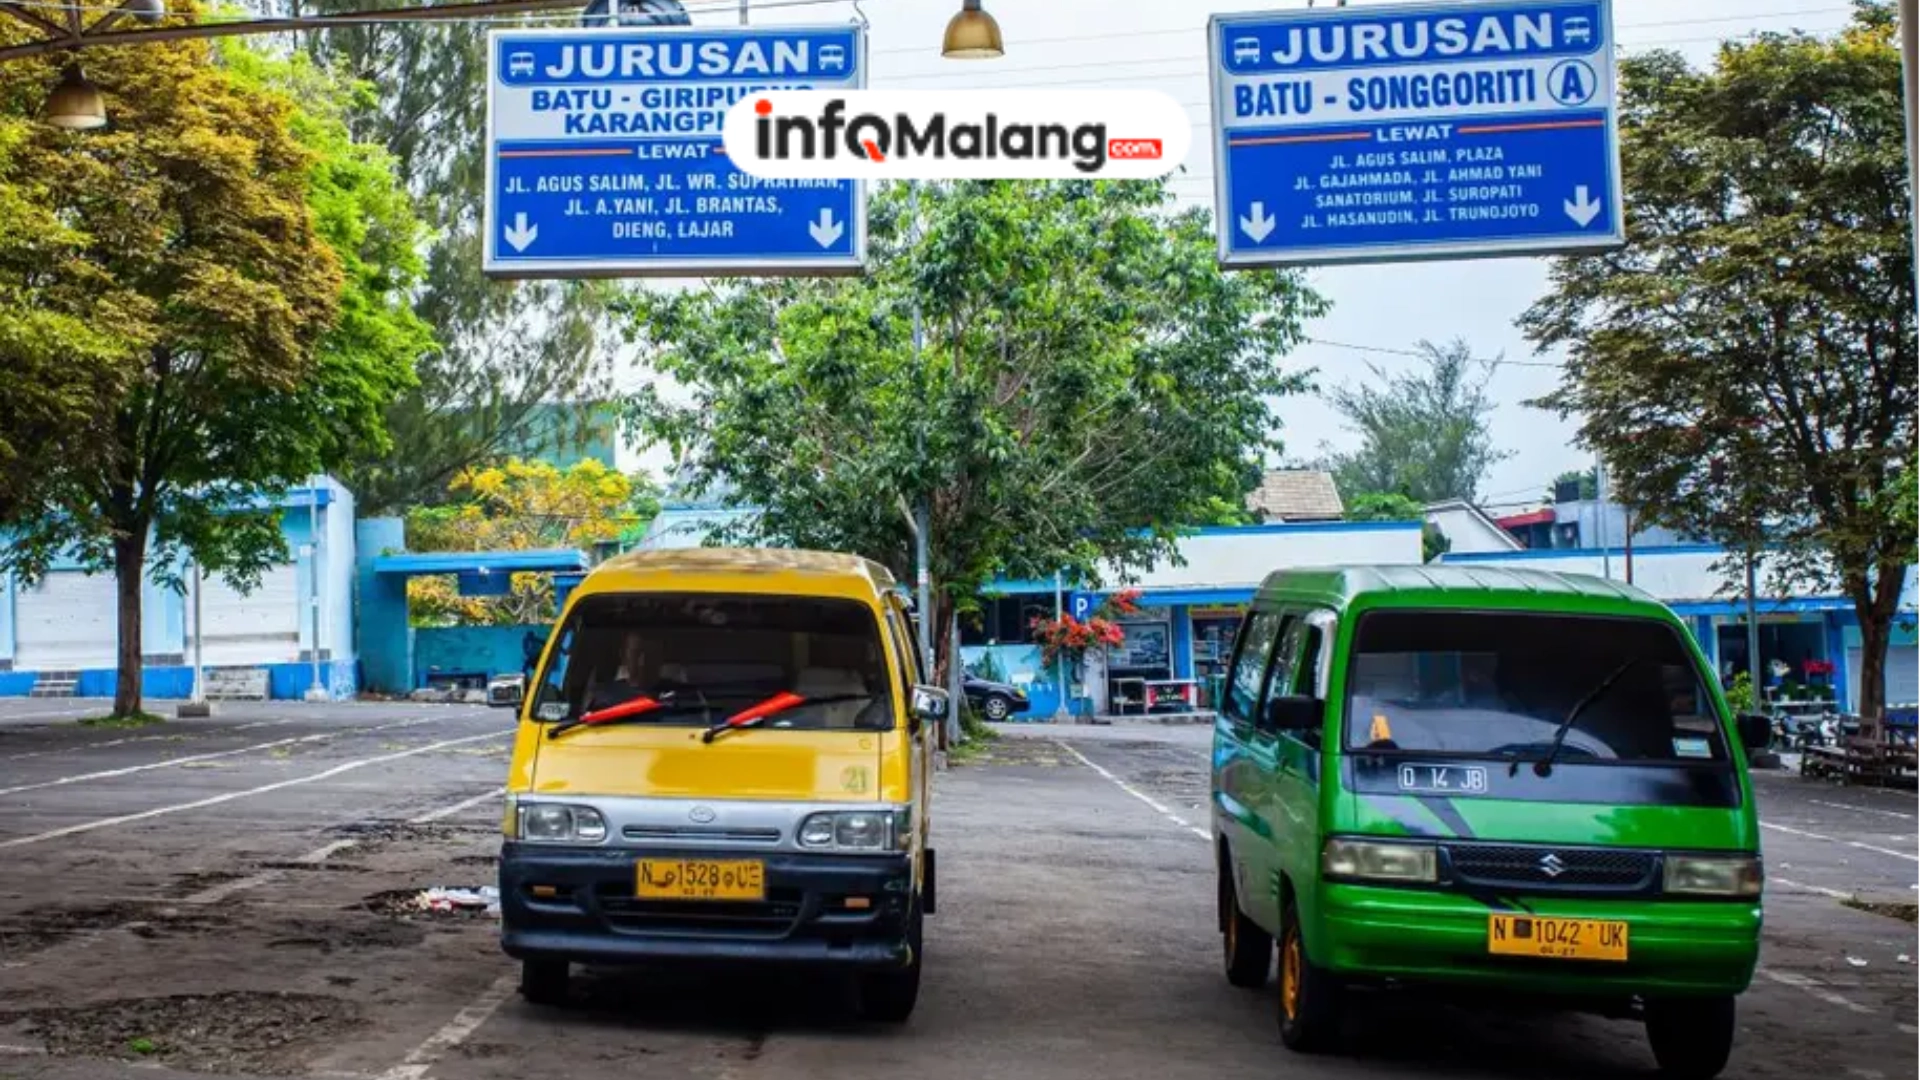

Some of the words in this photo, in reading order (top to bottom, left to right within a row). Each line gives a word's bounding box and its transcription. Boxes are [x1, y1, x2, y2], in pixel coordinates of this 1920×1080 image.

[1271, 13, 1553, 65] JURUSAN
[545, 40, 809, 78] JURUSAN
[532, 88, 612, 112] BATU
[640, 84, 813, 110] GIRIPU
[1234, 81, 1313, 118] BATU
[1347, 68, 1536, 112] SONGGORITI
[1560, 66, 1584, 99] A
[1376, 124, 1454, 143] LEWAT
[637, 143, 710, 160] LEWAT
[1329, 154, 1352, 169] JL.
[1355, 152, 1396, 167] AGUS
[1456, 146, 1504, 162] PLAZA
[505, 175, 531, 193] JL.
[536, 174, 583, 192] AGUS
[588, 173, 650, 193] SALIM,
[654, 173, 682, 191] JL.
[686, 173, 723, 191] WR.
[1293, 175, 1317, 190] JL.
[1319, 171, 1418, 188] GAJAHMADA,
[1422, 169, 1444, 183] JL.
[1448, 165, 1504, 182] AHMAD
[1507, 163, 1542, 178] YANI
[1422, 188, 1444, 203] JL.
[1448, 184, 1523, 201] SUROPATI
[563, 198, 591, 216] JL.
[664, 197, 690, 215] JL.
[696, 195, 783, 215] BRANTAS,
[1301, 214, 1323, 229] JL.
[1422, 208, 1444, 223] JL.
[1448, 203, 1540, 221] TRUNOJOYO
[612, 220, 672, 240] DIENG,
[677, 219, 734, 238] LAJAR
[1075, 597, 1089, 616] P
[1430, 767, 1448, 788] 14
[1460, 769, 1483, 789] JB
[642, 861, 652, 884] N
[677, 861, 719, 887] 1528
[1494, 917, 1506, 940] N
[1535, 920, 1581, 946] 1042
[1599, 923, 1624, 948] UK
